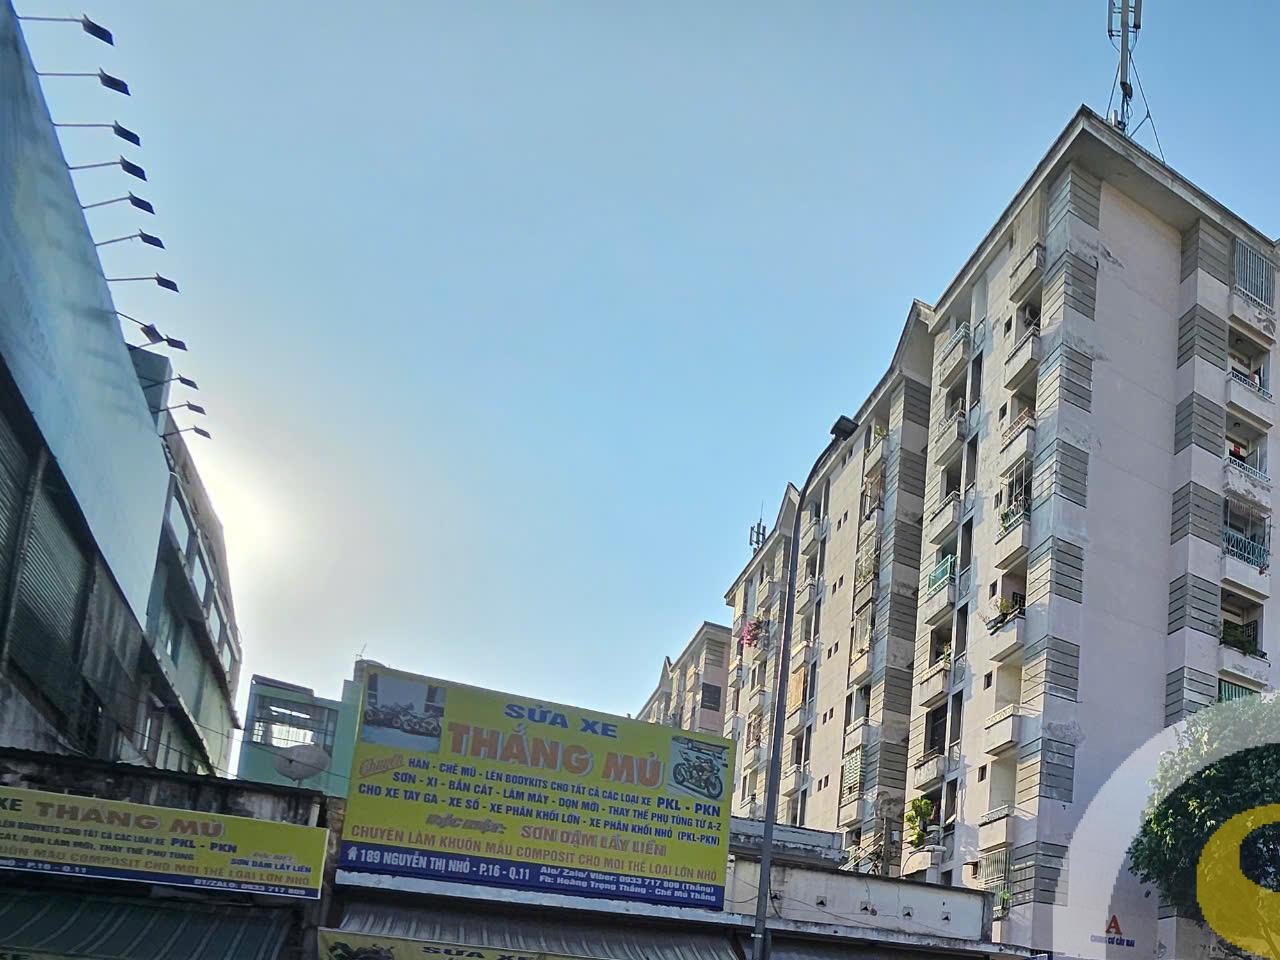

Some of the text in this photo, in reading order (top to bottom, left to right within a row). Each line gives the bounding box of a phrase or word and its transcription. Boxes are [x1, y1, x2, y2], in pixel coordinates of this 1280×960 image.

[504, 703, 618, 739] SỬA XE
[358, 783, 381, 796] CHO
[385, 787, 399, 799] XE
[424, 793, 438, 804] GA
[448, 797, 462, 809] XE
[489, 803, 502, 814] XE
[589, 818, 601, 829] XE
[677, 831, 720, 846] (PKL-PKN)
[608, 805, 630, 817] THAY
[641, 796, 651, 806] XE
[656, 797, 681, 812] PKL
[694, 802, 721, 817] PKN
[210, 842, 237, 853] PKN
[360, 849, 380, 863] 189
[479, 863, 500, 877] P.16
[509, 867, 530, 882] Q.11
[579, 855, 600, 868] CHO
[644, 878, 661, 887] 717
[1105, 914, 1122, 935] A
